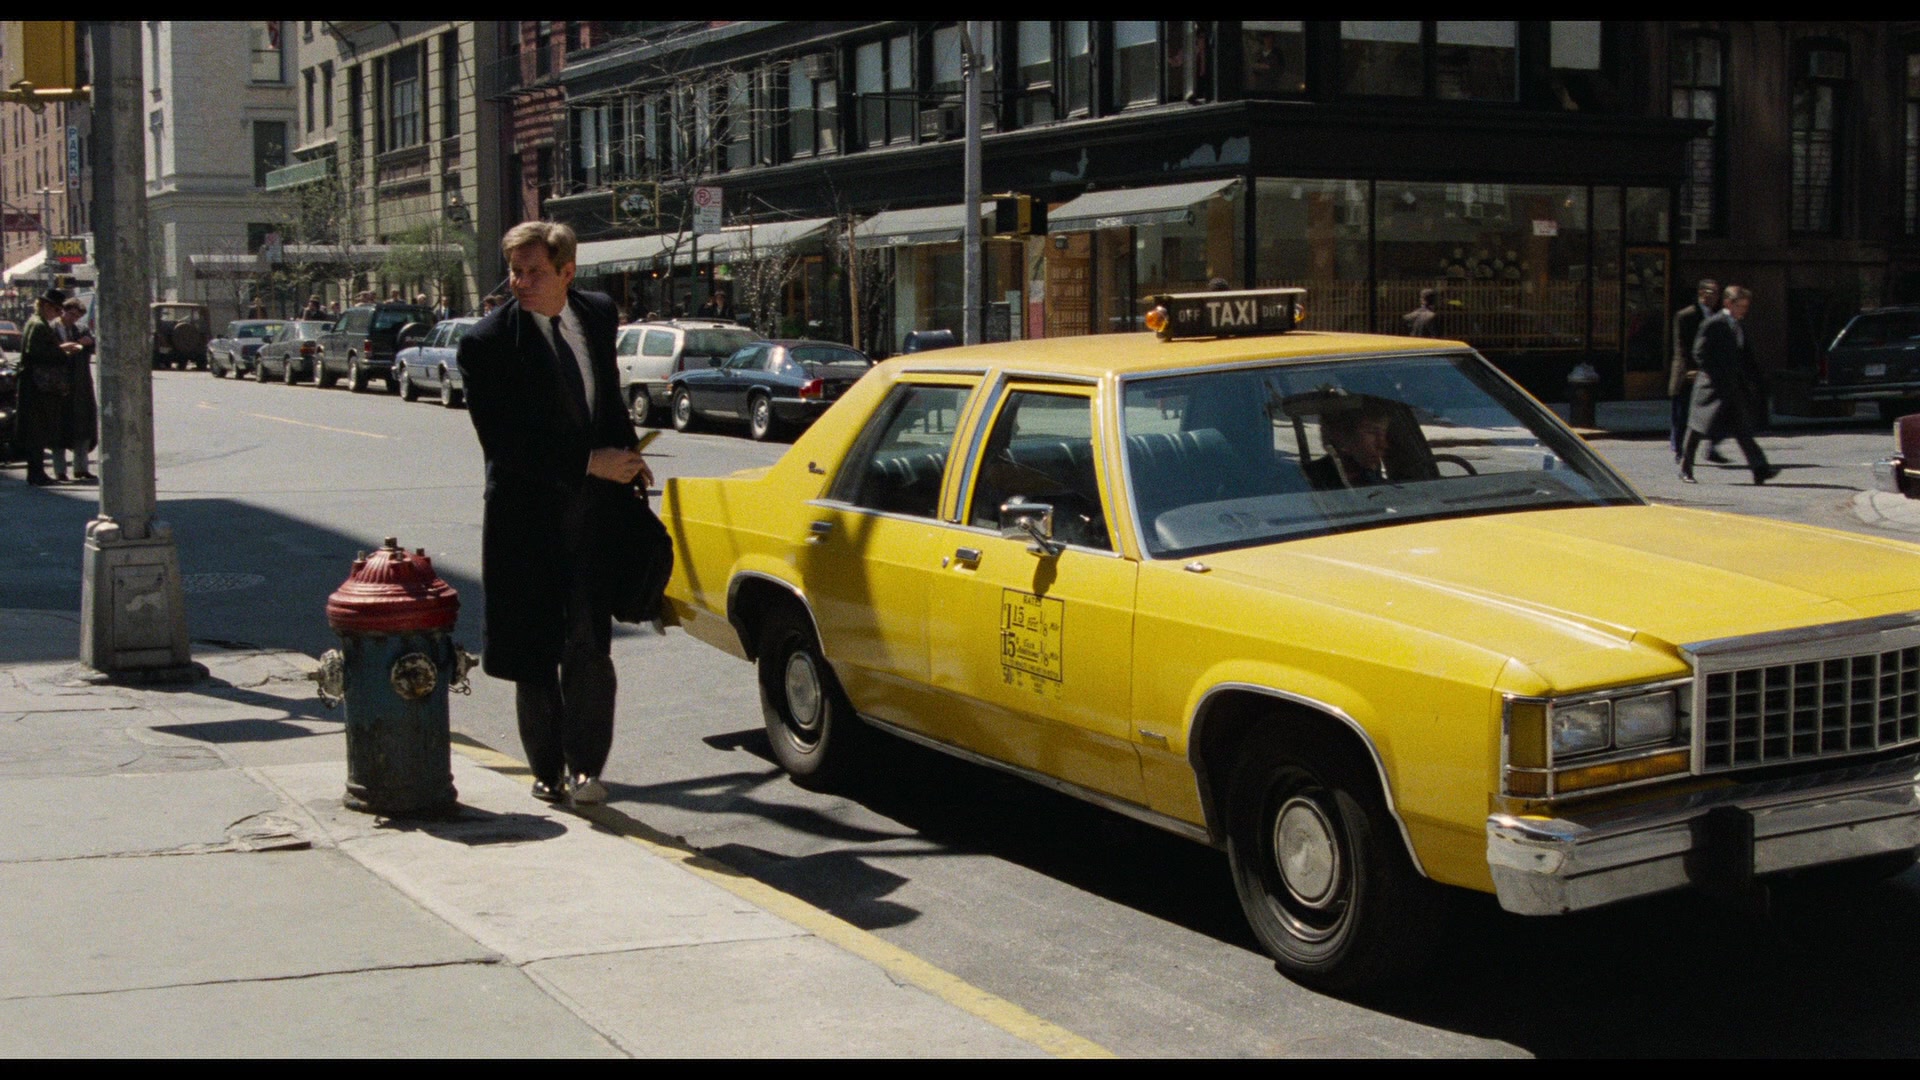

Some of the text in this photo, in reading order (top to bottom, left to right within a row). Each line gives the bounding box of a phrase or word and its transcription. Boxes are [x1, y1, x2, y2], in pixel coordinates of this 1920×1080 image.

[68, 127, 78, 174] PARK
[52, 241, 82, 255] PARK
[1179, 300, 1288, 327] OFF TAXI DUTY
